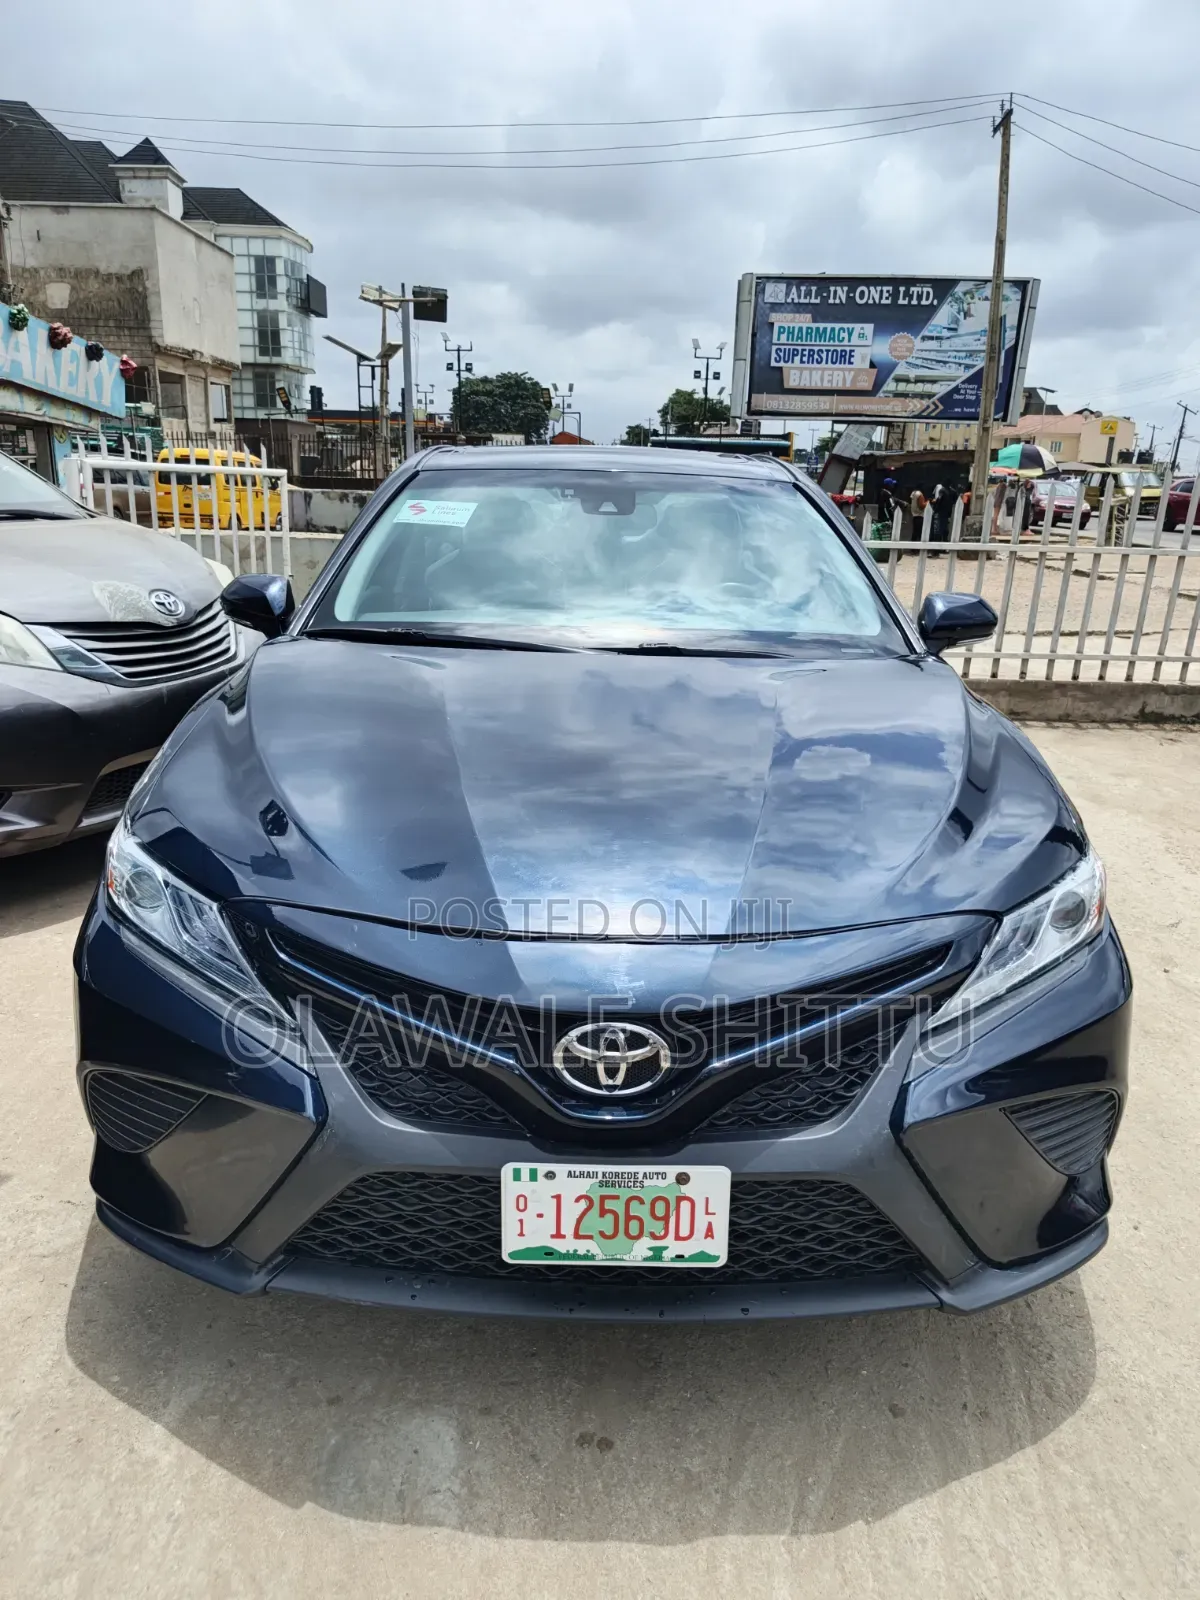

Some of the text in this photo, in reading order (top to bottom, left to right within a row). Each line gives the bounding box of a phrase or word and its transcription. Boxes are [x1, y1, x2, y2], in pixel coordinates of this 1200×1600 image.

[787, 286, 938, 305] ALL-IN-ONE LTD.
[777, 325, 855, 344] PHARMACY
[0, 317, 120, 407] AKERY
[774, 347, 856, 365] SUPERSTORE
[788, 369, 855, 388] BAKERY
[567, 1170, 667, 1180] ALHAJI KOREDE AUTO
[598, 1179, 645, 1189] SERVICES
